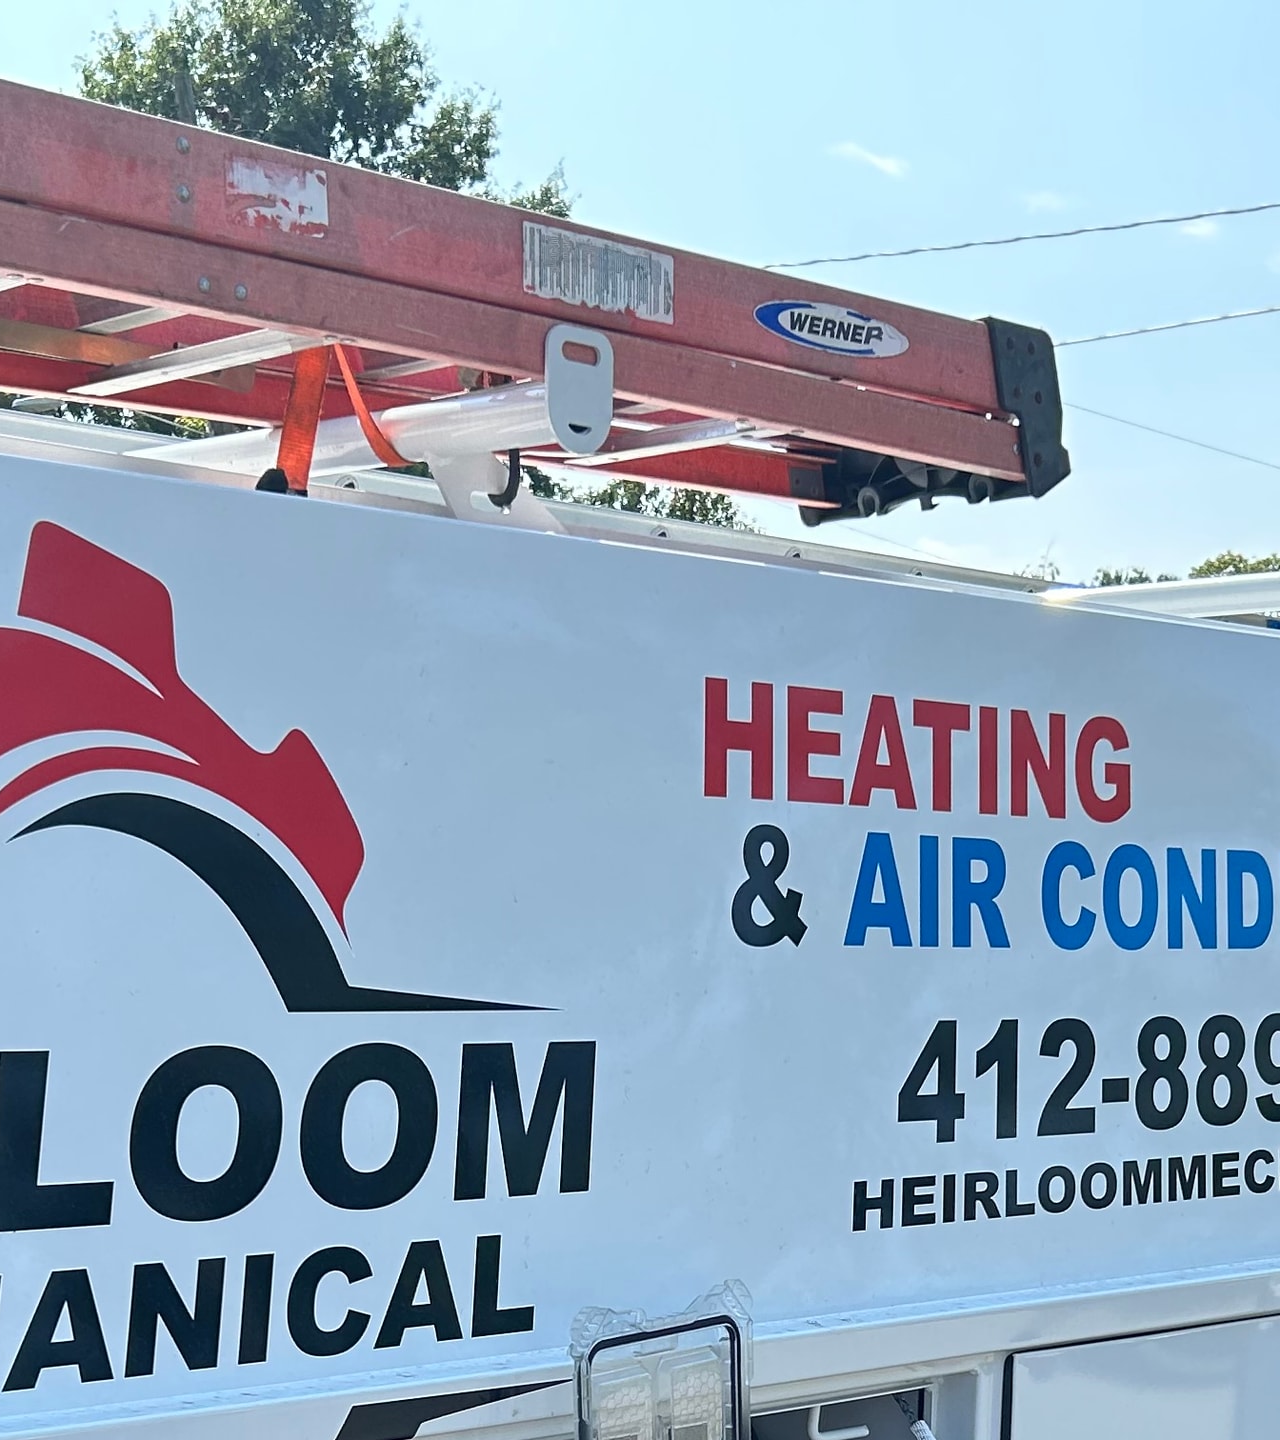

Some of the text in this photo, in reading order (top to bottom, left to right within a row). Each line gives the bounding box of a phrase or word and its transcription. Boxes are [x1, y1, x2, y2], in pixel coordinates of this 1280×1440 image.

[789, 311, 884, 345] WERNER
[704, 677, 1131, 823] HEATING
[731, 824, 808, 947] &
[844, 831, 1010, 949] AIR
